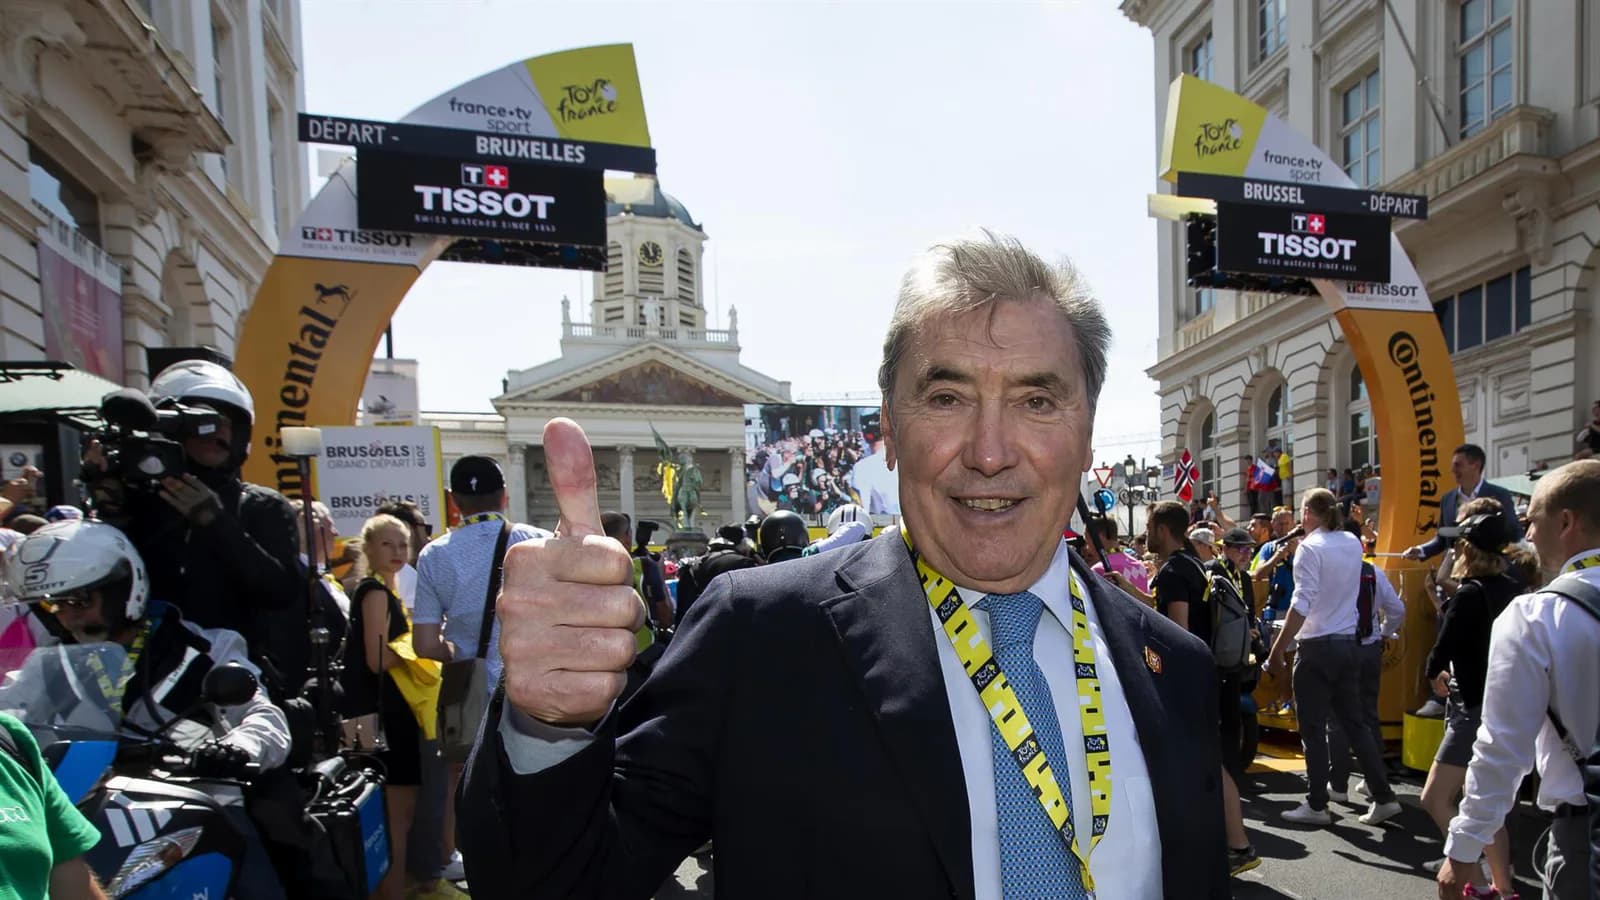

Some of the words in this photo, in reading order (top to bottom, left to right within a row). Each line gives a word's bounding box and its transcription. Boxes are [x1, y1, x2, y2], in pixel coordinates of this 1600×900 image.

[558, 98, 617, 124] france
[487, 118, 531, 134] sport
[308, 116, 387, 145] DÉPART
[475, 135, 586, 164] BRUXELLES
[1194, 135, 1241, 159] france
[1289, 168, 1321, 183] sport
[413, 184, 556, 220] TISSOT
[1243, 182, 1305, 205] BRUSSEL
[1370, 192, 1419, 216] DÉPART
[333, 227, 415, 248] TISSOT
[1257, 231, 1357, 261] TISSOT
[1367, 283, 1419, 297] TISSOT
[1388, 331, 1441, 508] Continental
[328, 459, 368, 469] GRAND
[416, 445, 426, 468] 2019
